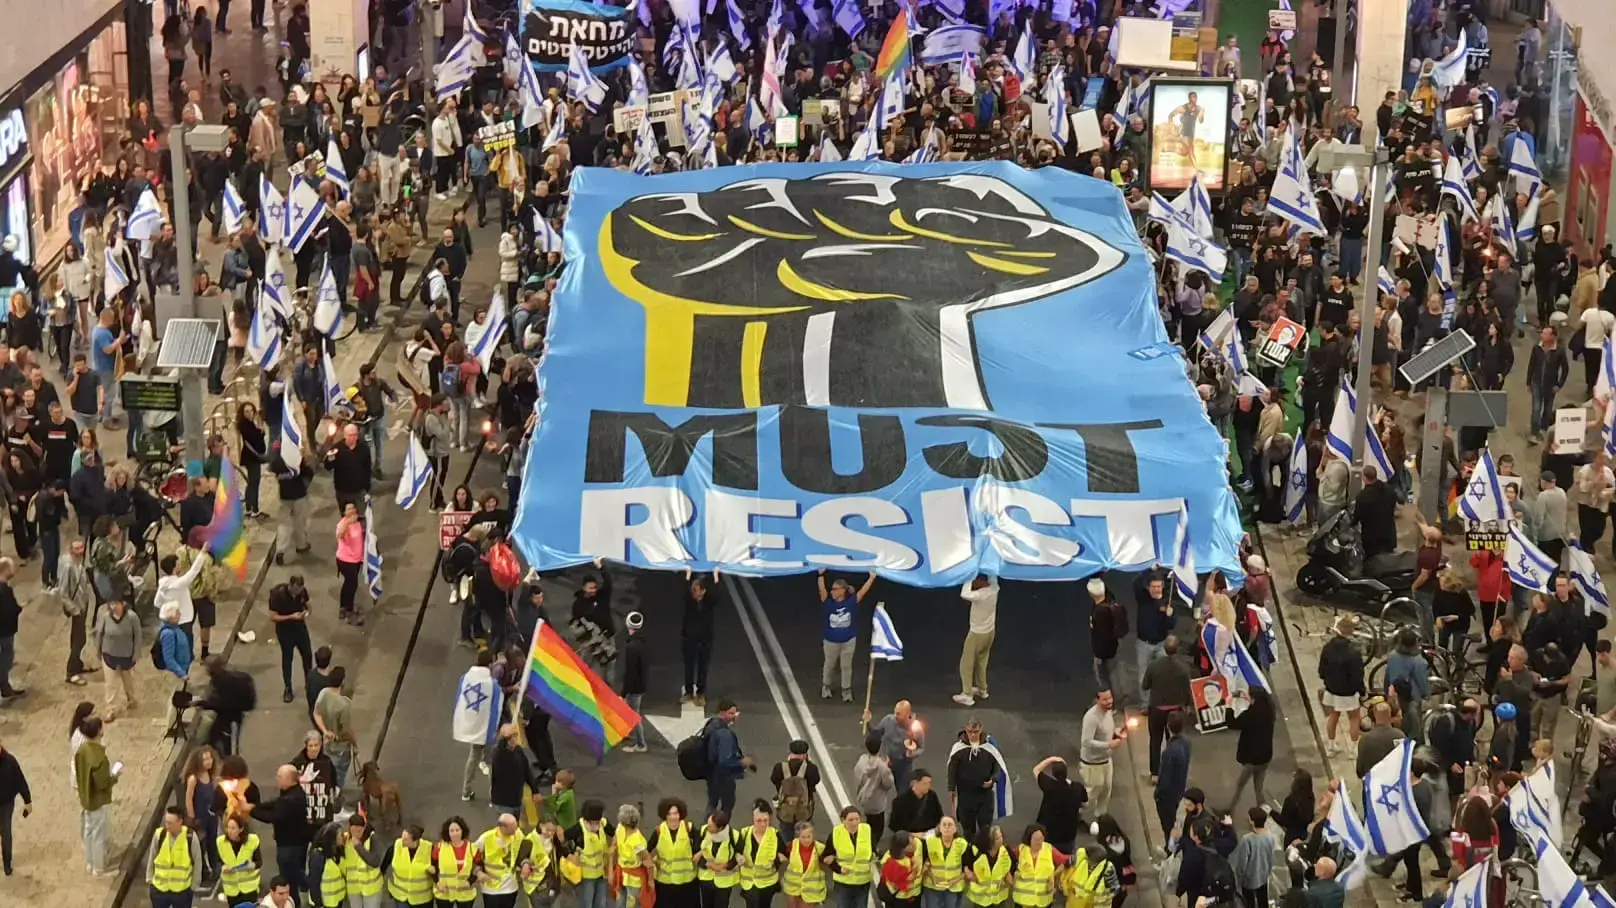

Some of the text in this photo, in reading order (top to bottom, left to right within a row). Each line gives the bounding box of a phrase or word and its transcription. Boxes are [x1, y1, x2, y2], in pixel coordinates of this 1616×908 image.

[549, 16, 625, 41] מחאת
[584, 404, 1165, 494] MUST
[580, 484, 1187, 576] RESIST
